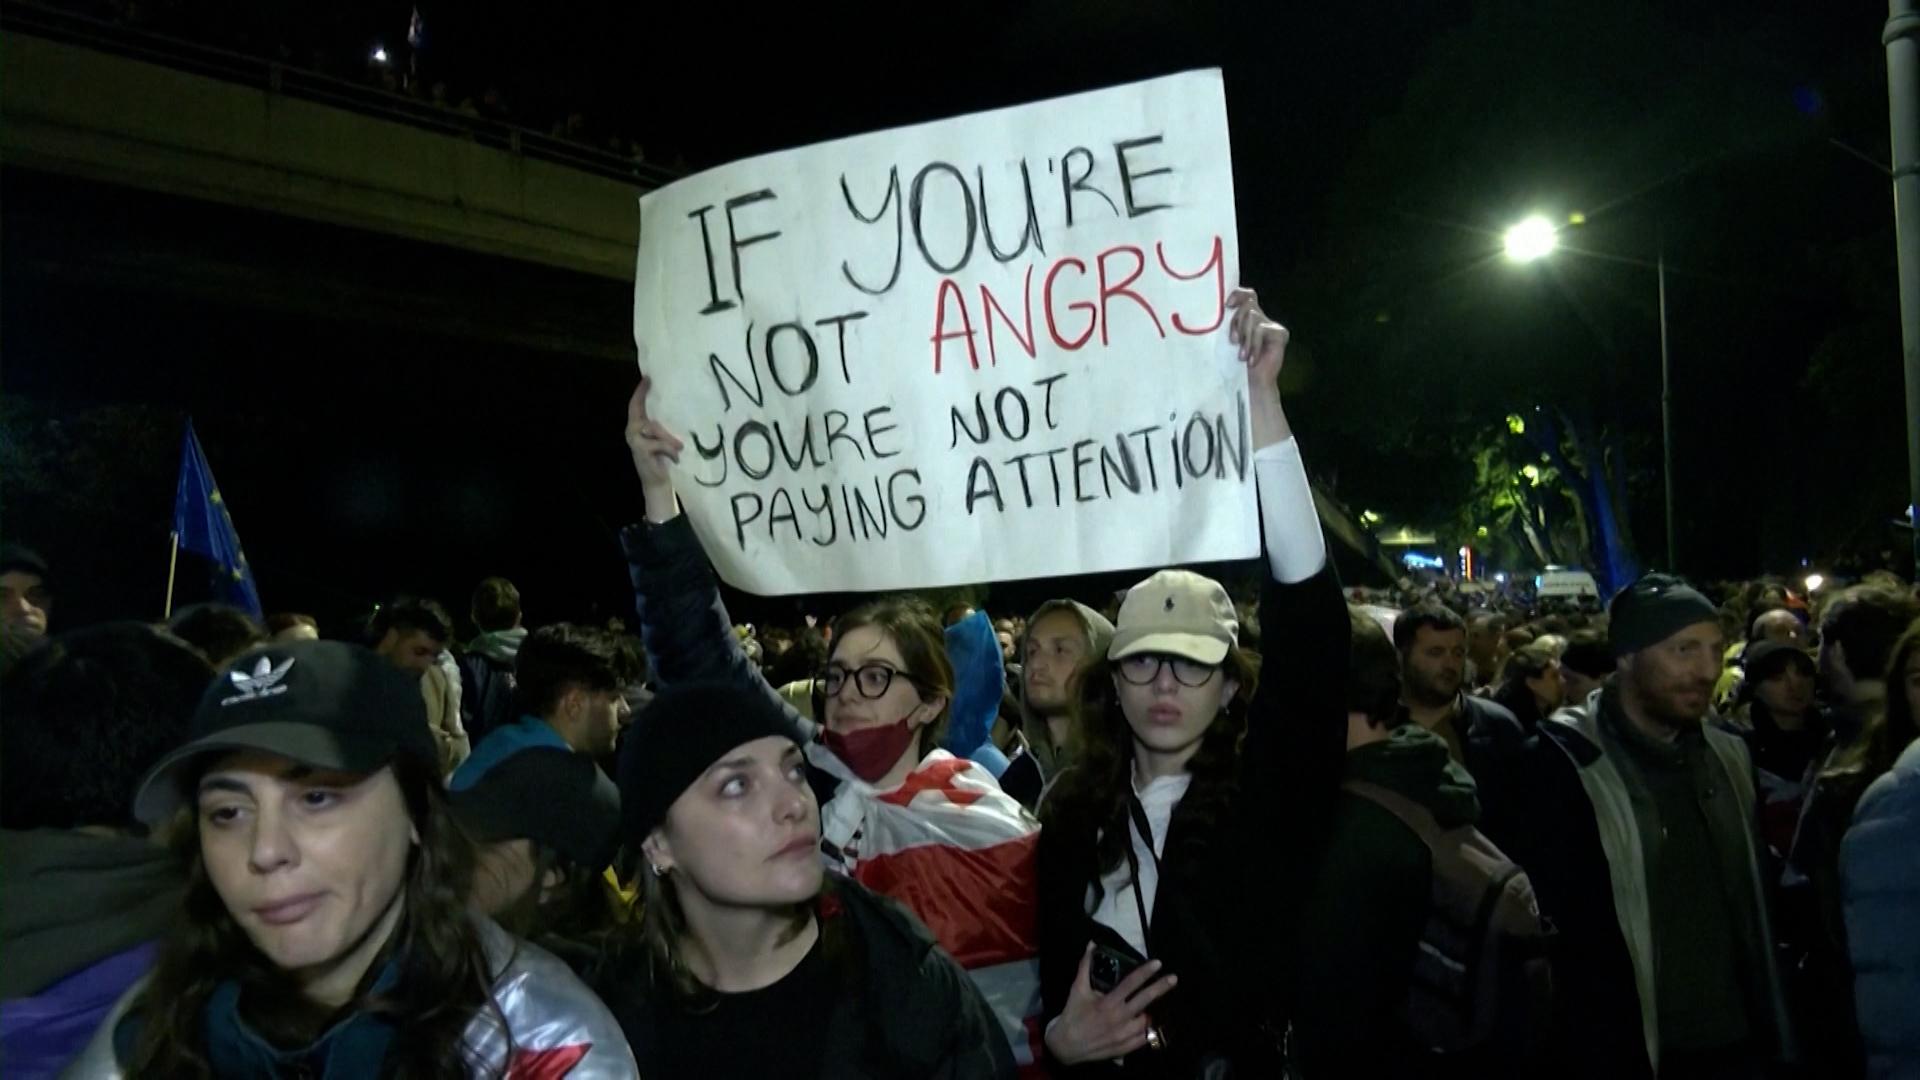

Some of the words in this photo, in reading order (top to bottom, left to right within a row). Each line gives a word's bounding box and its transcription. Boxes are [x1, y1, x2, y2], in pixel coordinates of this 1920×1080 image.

[688, 188, 782, 315] IF
[841, 135, 1173, 295] YOU'RE
[709, 311, 869, 411] NOT
[930, 236, 1226, 374] ANGRY
[950, 374, 1067, 450] NOT
[731, 469, 927, 552] PAYING
